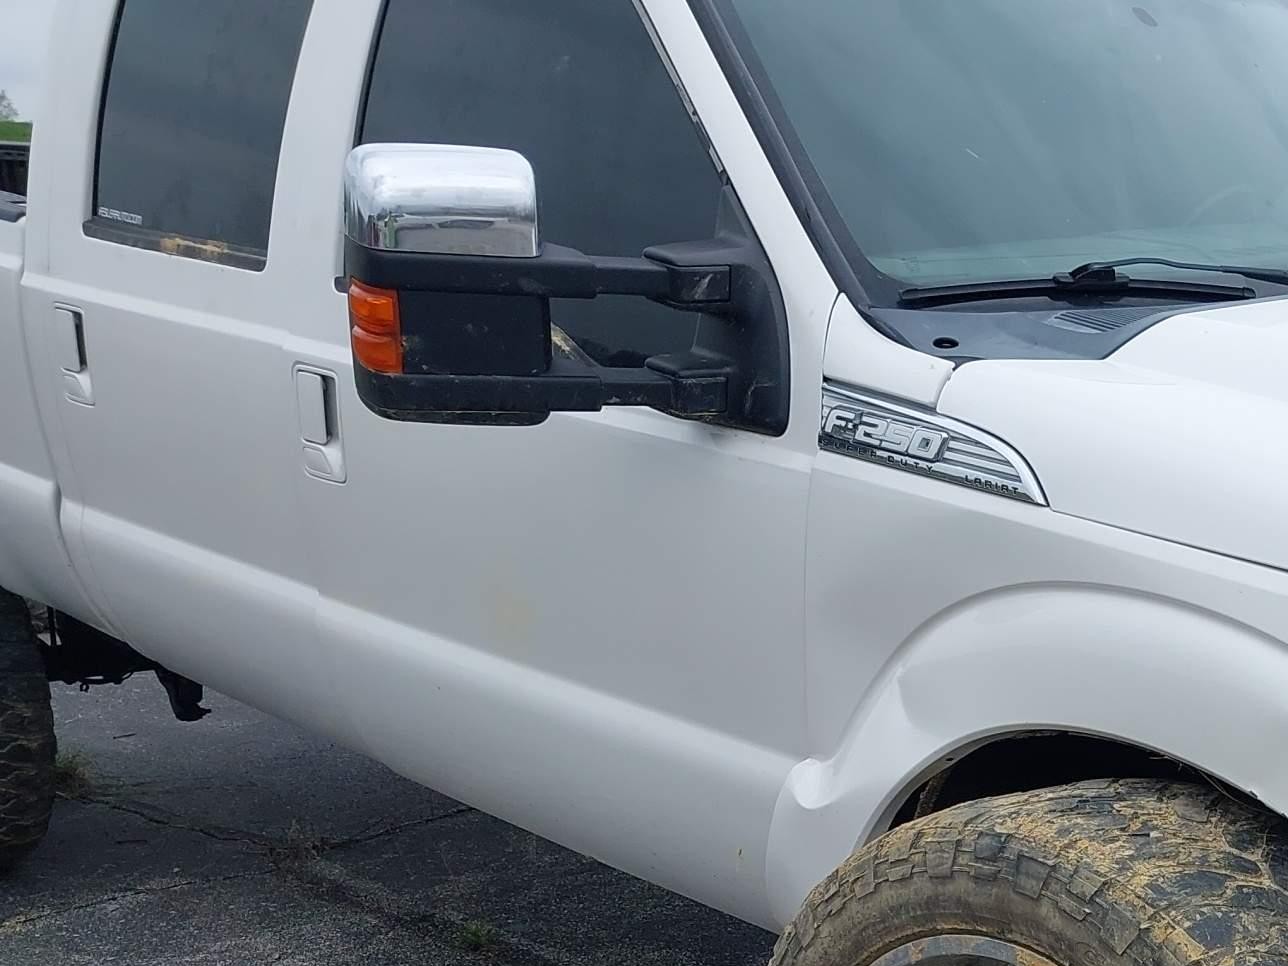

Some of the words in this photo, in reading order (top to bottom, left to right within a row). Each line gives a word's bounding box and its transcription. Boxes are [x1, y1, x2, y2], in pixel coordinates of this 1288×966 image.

[822, 407, 949, 462] F-250
[887, 454, 934, 473] DUTY
[964, 474, 1019, 495] LARIAT
